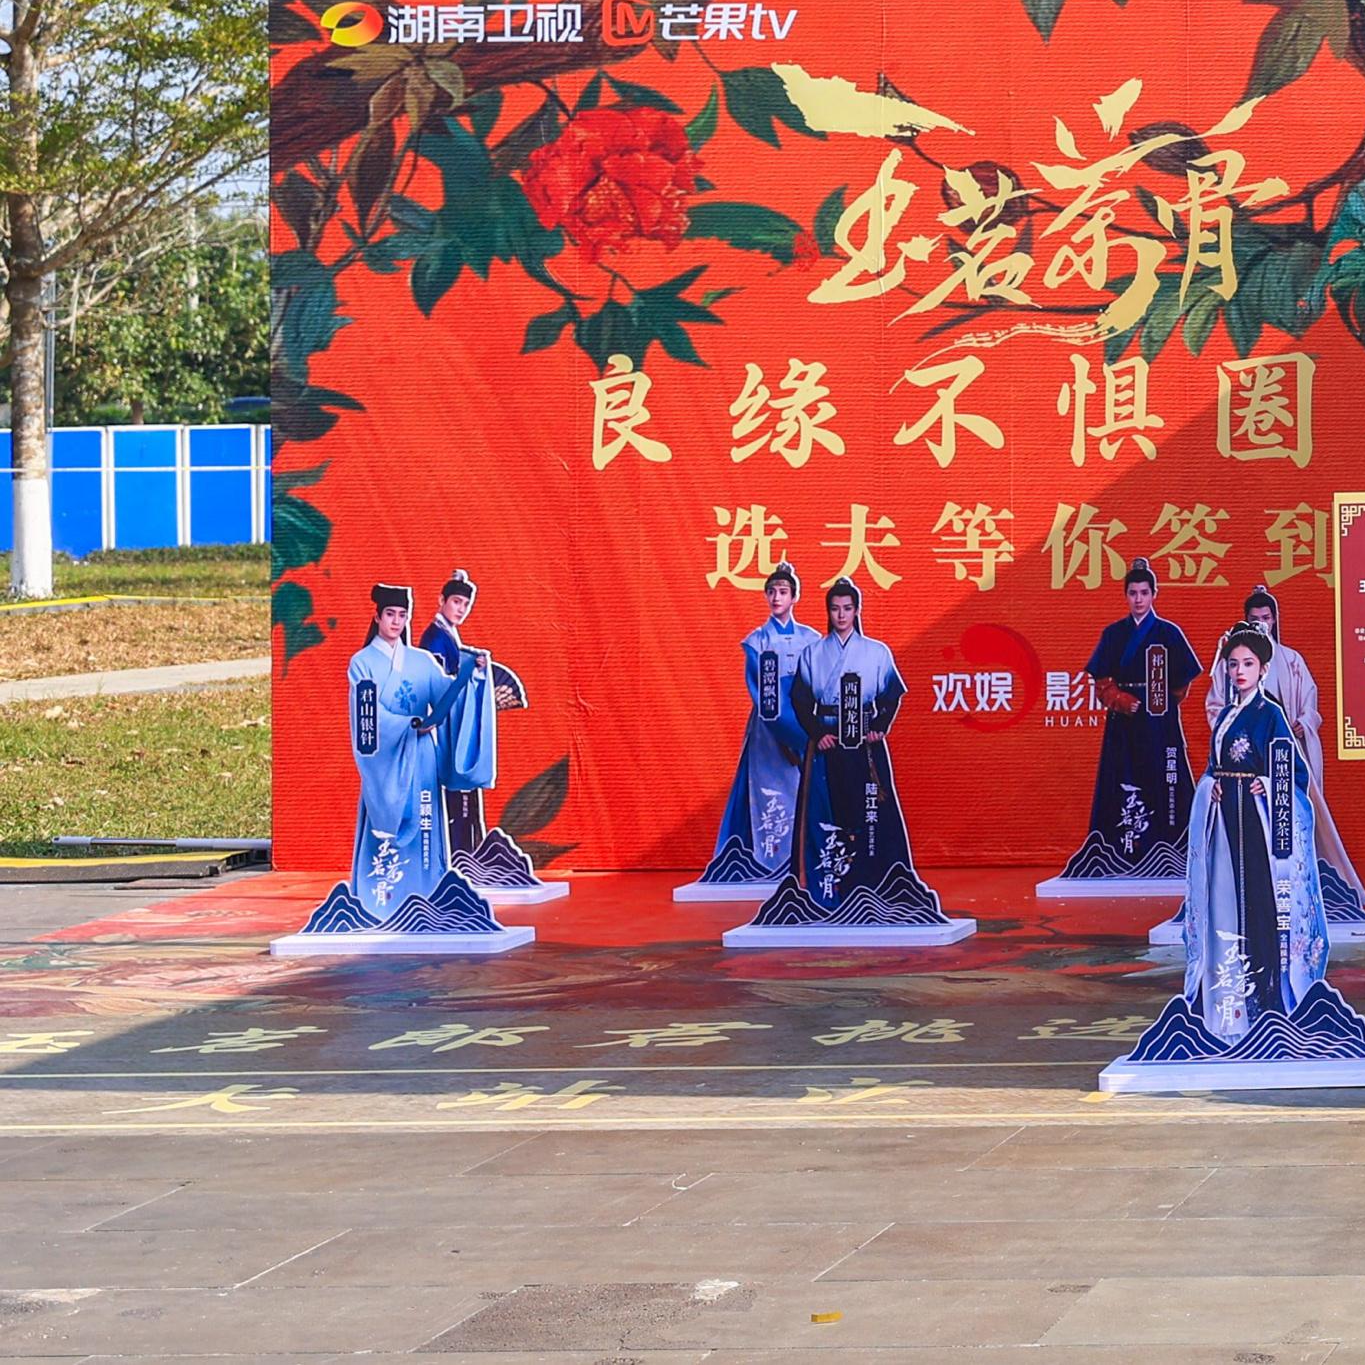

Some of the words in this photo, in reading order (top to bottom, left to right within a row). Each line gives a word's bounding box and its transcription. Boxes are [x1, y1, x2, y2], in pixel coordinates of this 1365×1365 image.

[387, 3, 583, 44] 湖南卫视
[659, 2, 798, 41] 芒果tv
[771, 62, 1290, 344] 玉茗茶骨
[705, 501, 1334, 594] 选夫等你签到
[1151, 653, 1164, 707] 祁门红茶
[359, 688, 375, 746] 君山银针
[844, 681, 859, 739] 西湖龙井
[1045, 716, 1107, 727] HUAN
[1166, 747, 1177, 784] 贺星明
[865, 782, 878, 823] 陆江来
[1274, 747, 1290, 853] 腹黑商战女茶王
